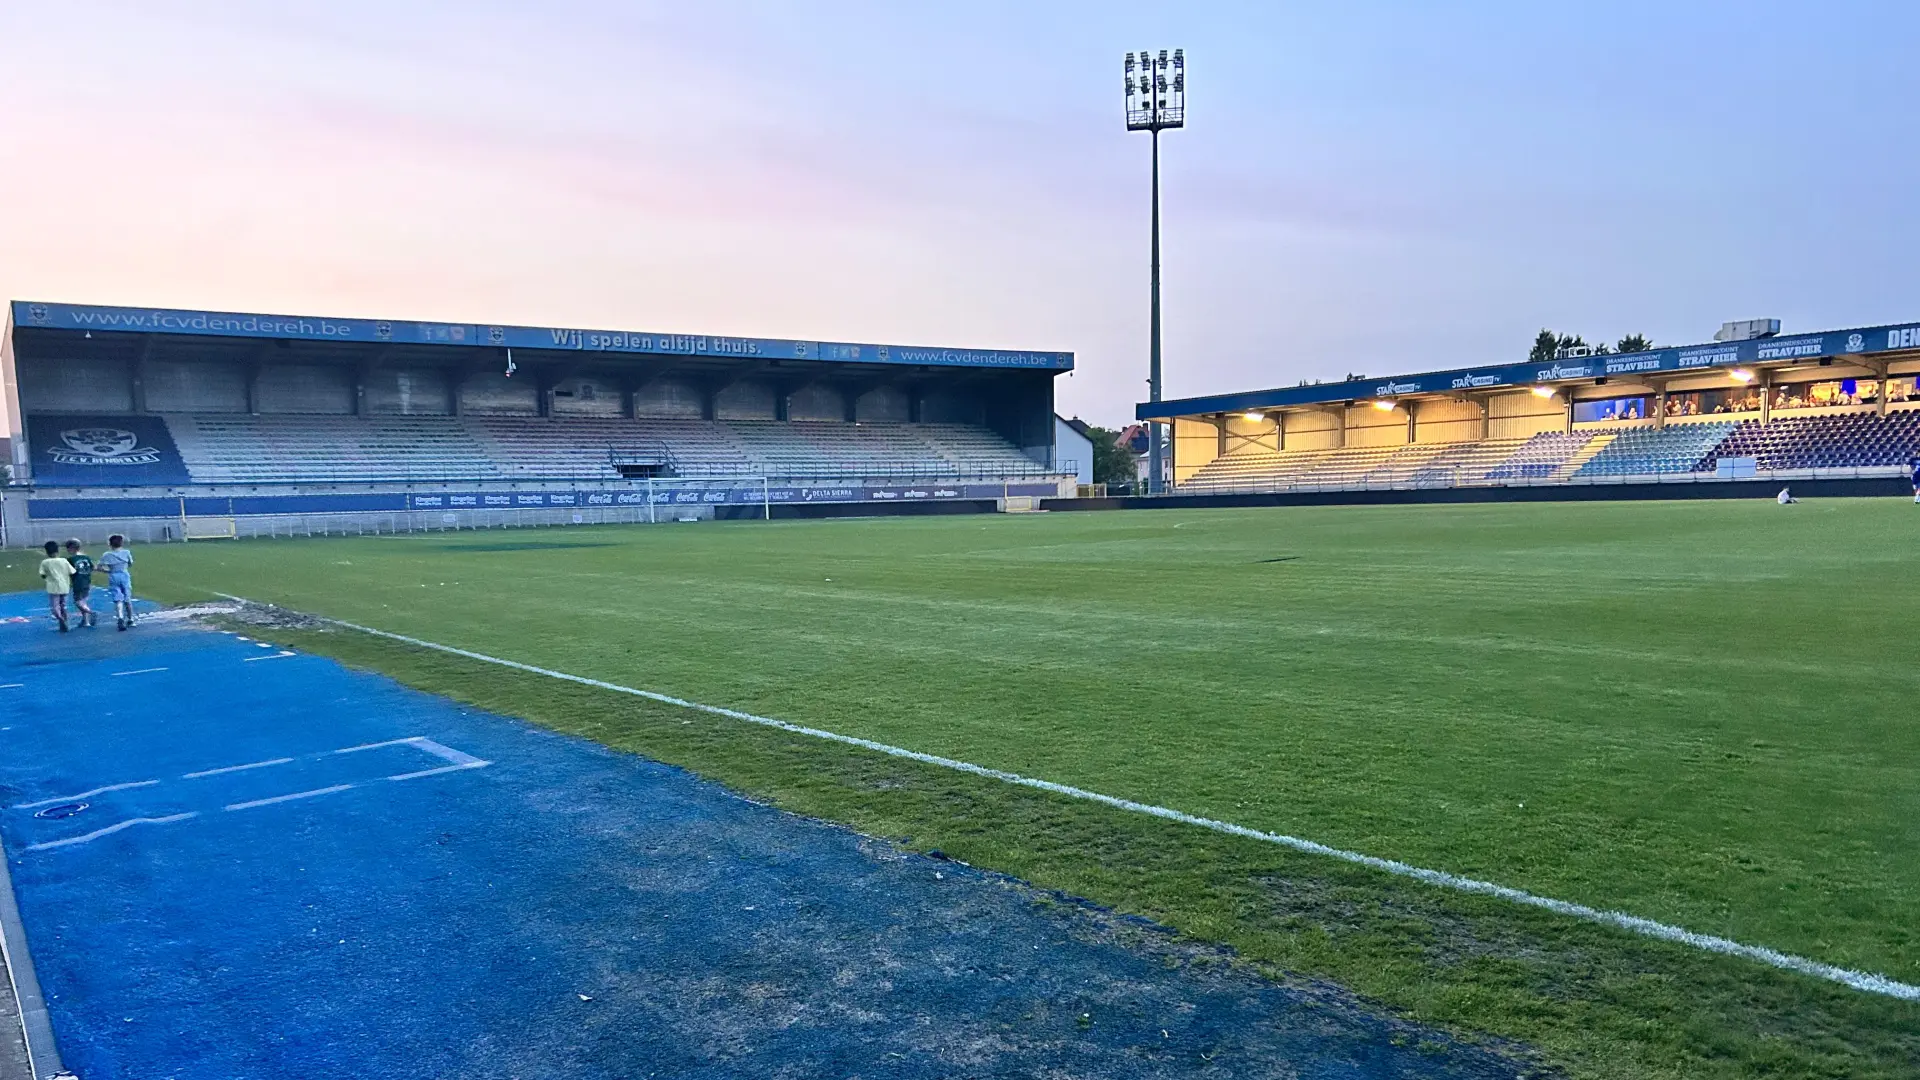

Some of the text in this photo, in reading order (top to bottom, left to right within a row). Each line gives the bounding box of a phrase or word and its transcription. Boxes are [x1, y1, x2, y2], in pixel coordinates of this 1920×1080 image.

[71, 310, 351, 336] www.fcvdendereh.be
[551, 329, 762, 354] Wij spelen altijd thuis.
[901, 350, 1047, 365] www.fcvdendereh.be
[1758, 344, 1822, 359] STRAVBIER
[1678, 353, 1737, 366] STRAVBIER
[1606, 361, 1660, 373] STRAVBIER
[1537, 368, 1558, 380] STAR
[1561, 369, 1582, 377] CASINO
[1452, 377, 1471, 388] STAR
[1376, 384, 1394, 396] STAR
